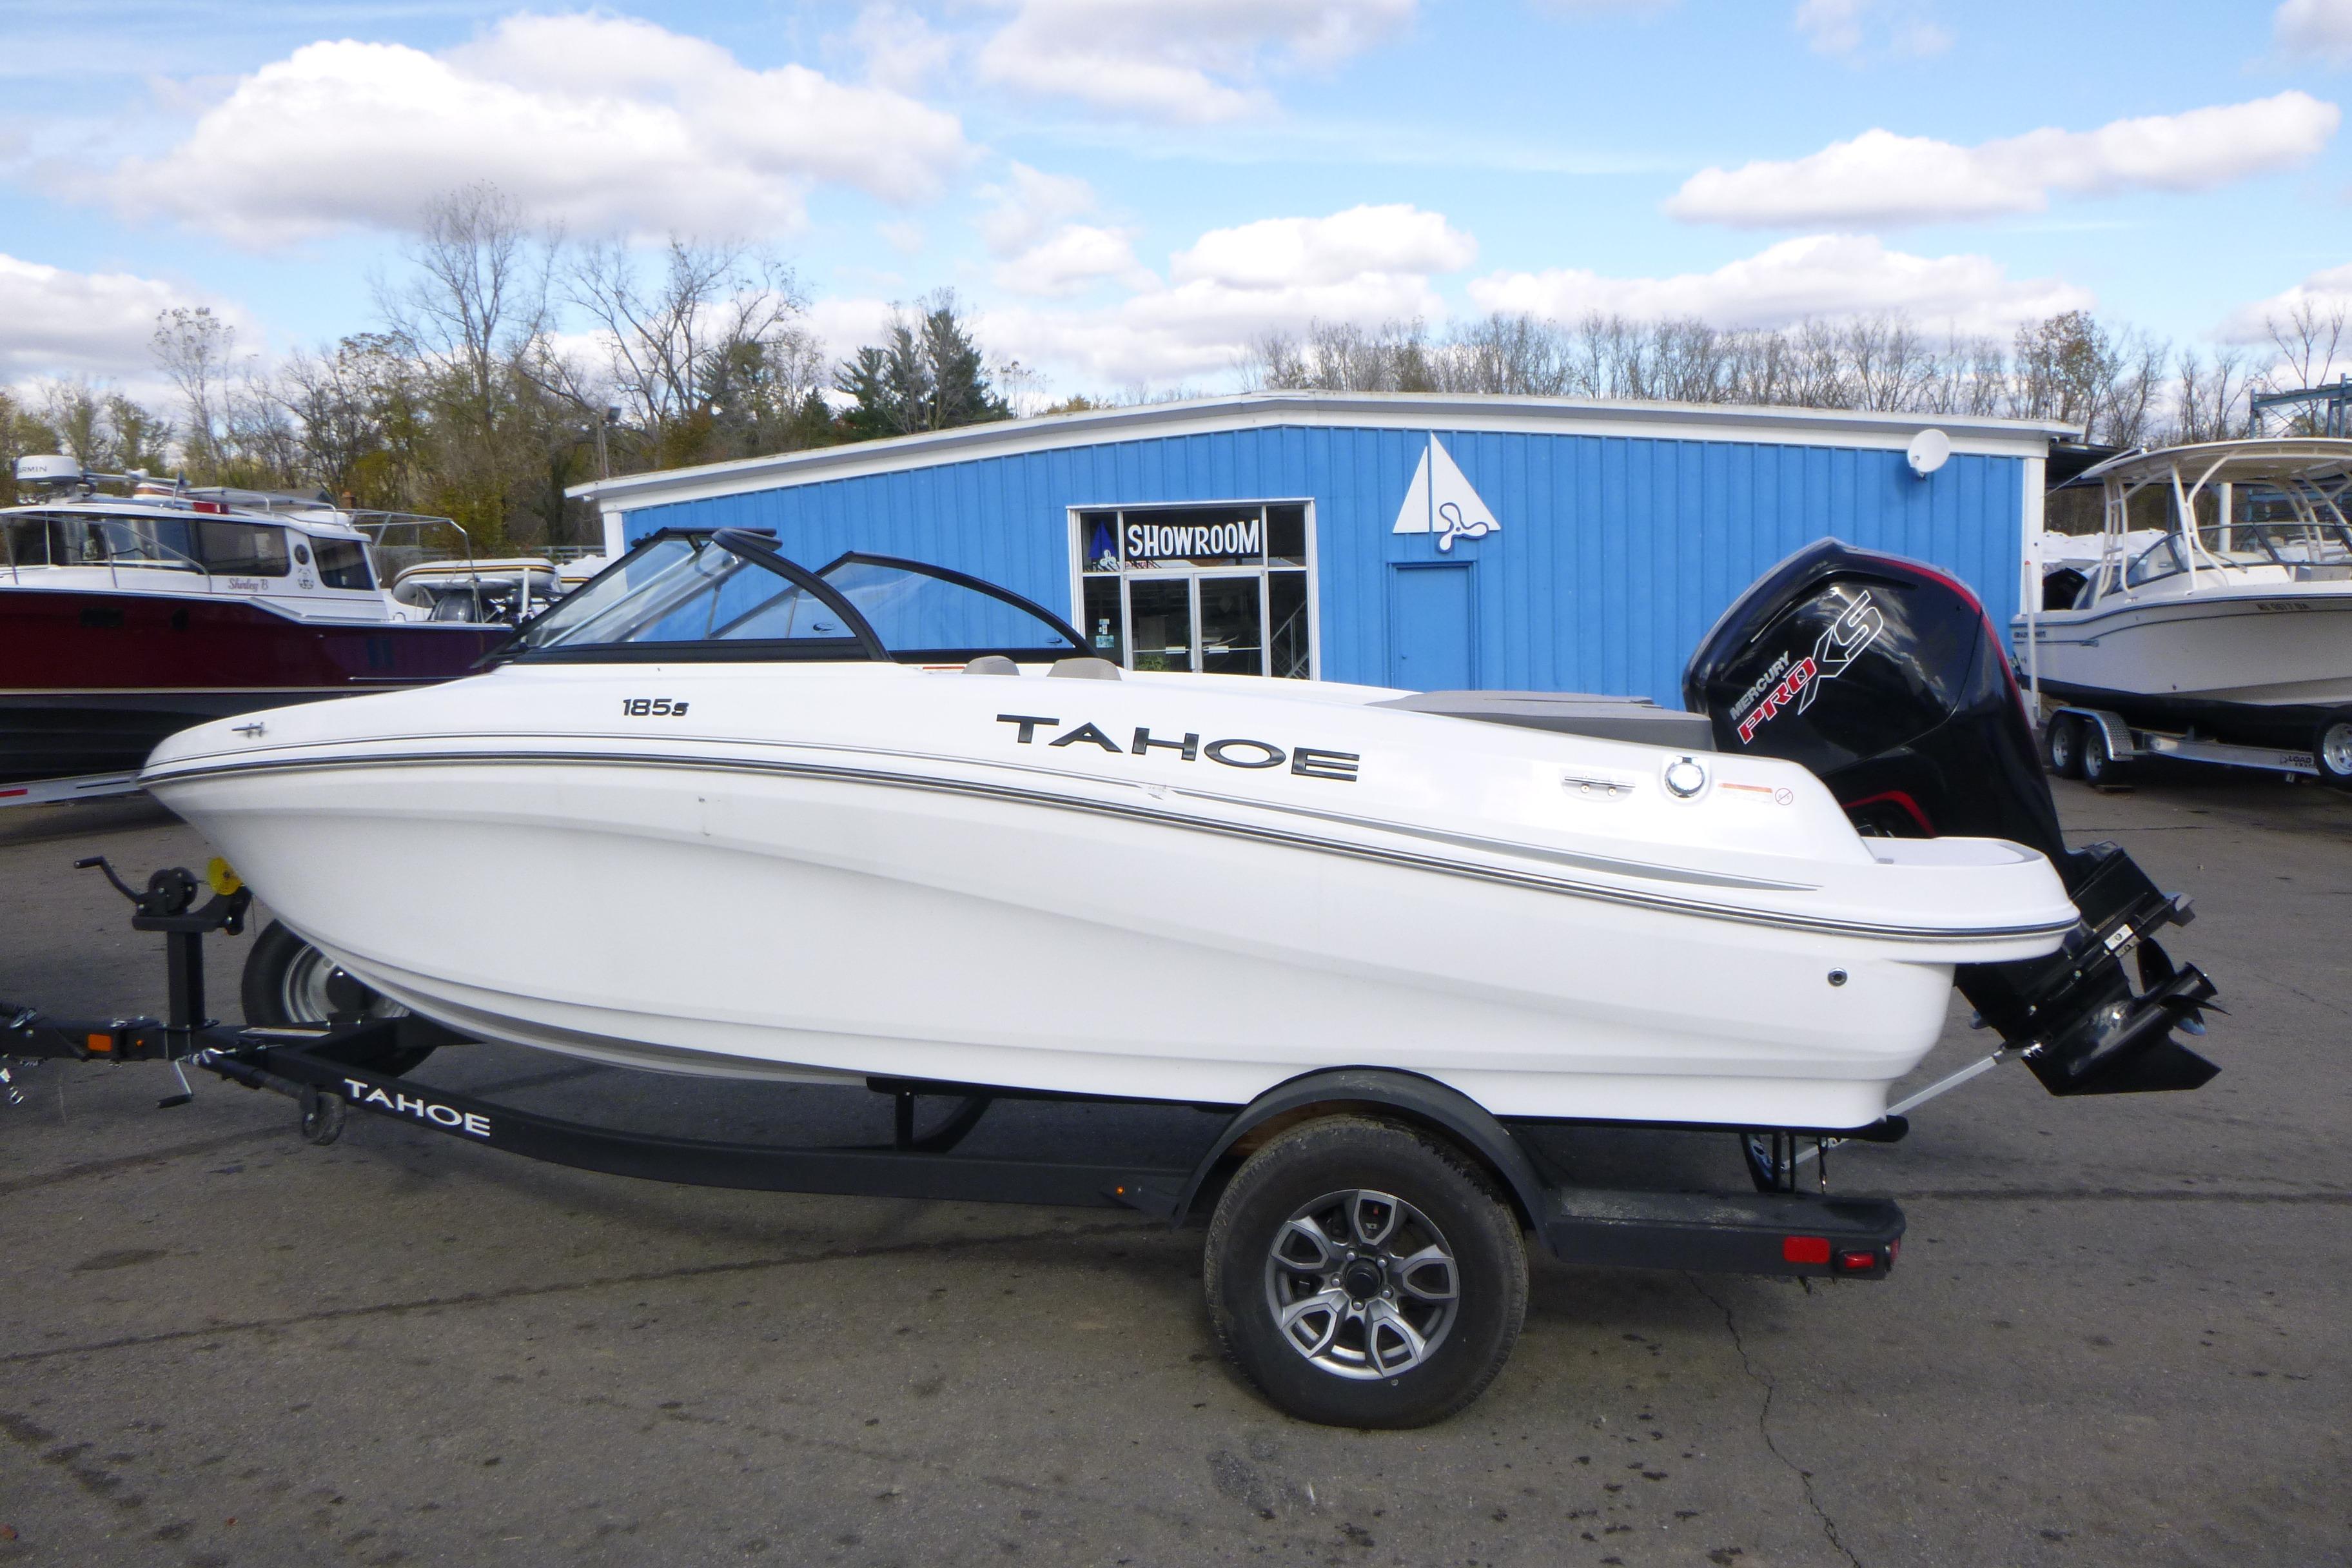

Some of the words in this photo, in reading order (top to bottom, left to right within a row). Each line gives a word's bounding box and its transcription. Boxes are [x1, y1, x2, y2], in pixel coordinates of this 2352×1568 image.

[1128, 519, 1259, 557] SHOWROOM
[1729, 650, 1790, 721] MERCURY
[1738, 656, 1817, 745] PRO
[996, 714, 1360, 782] TAHOE
[344, 1077, 491, 1137] TAHOE
